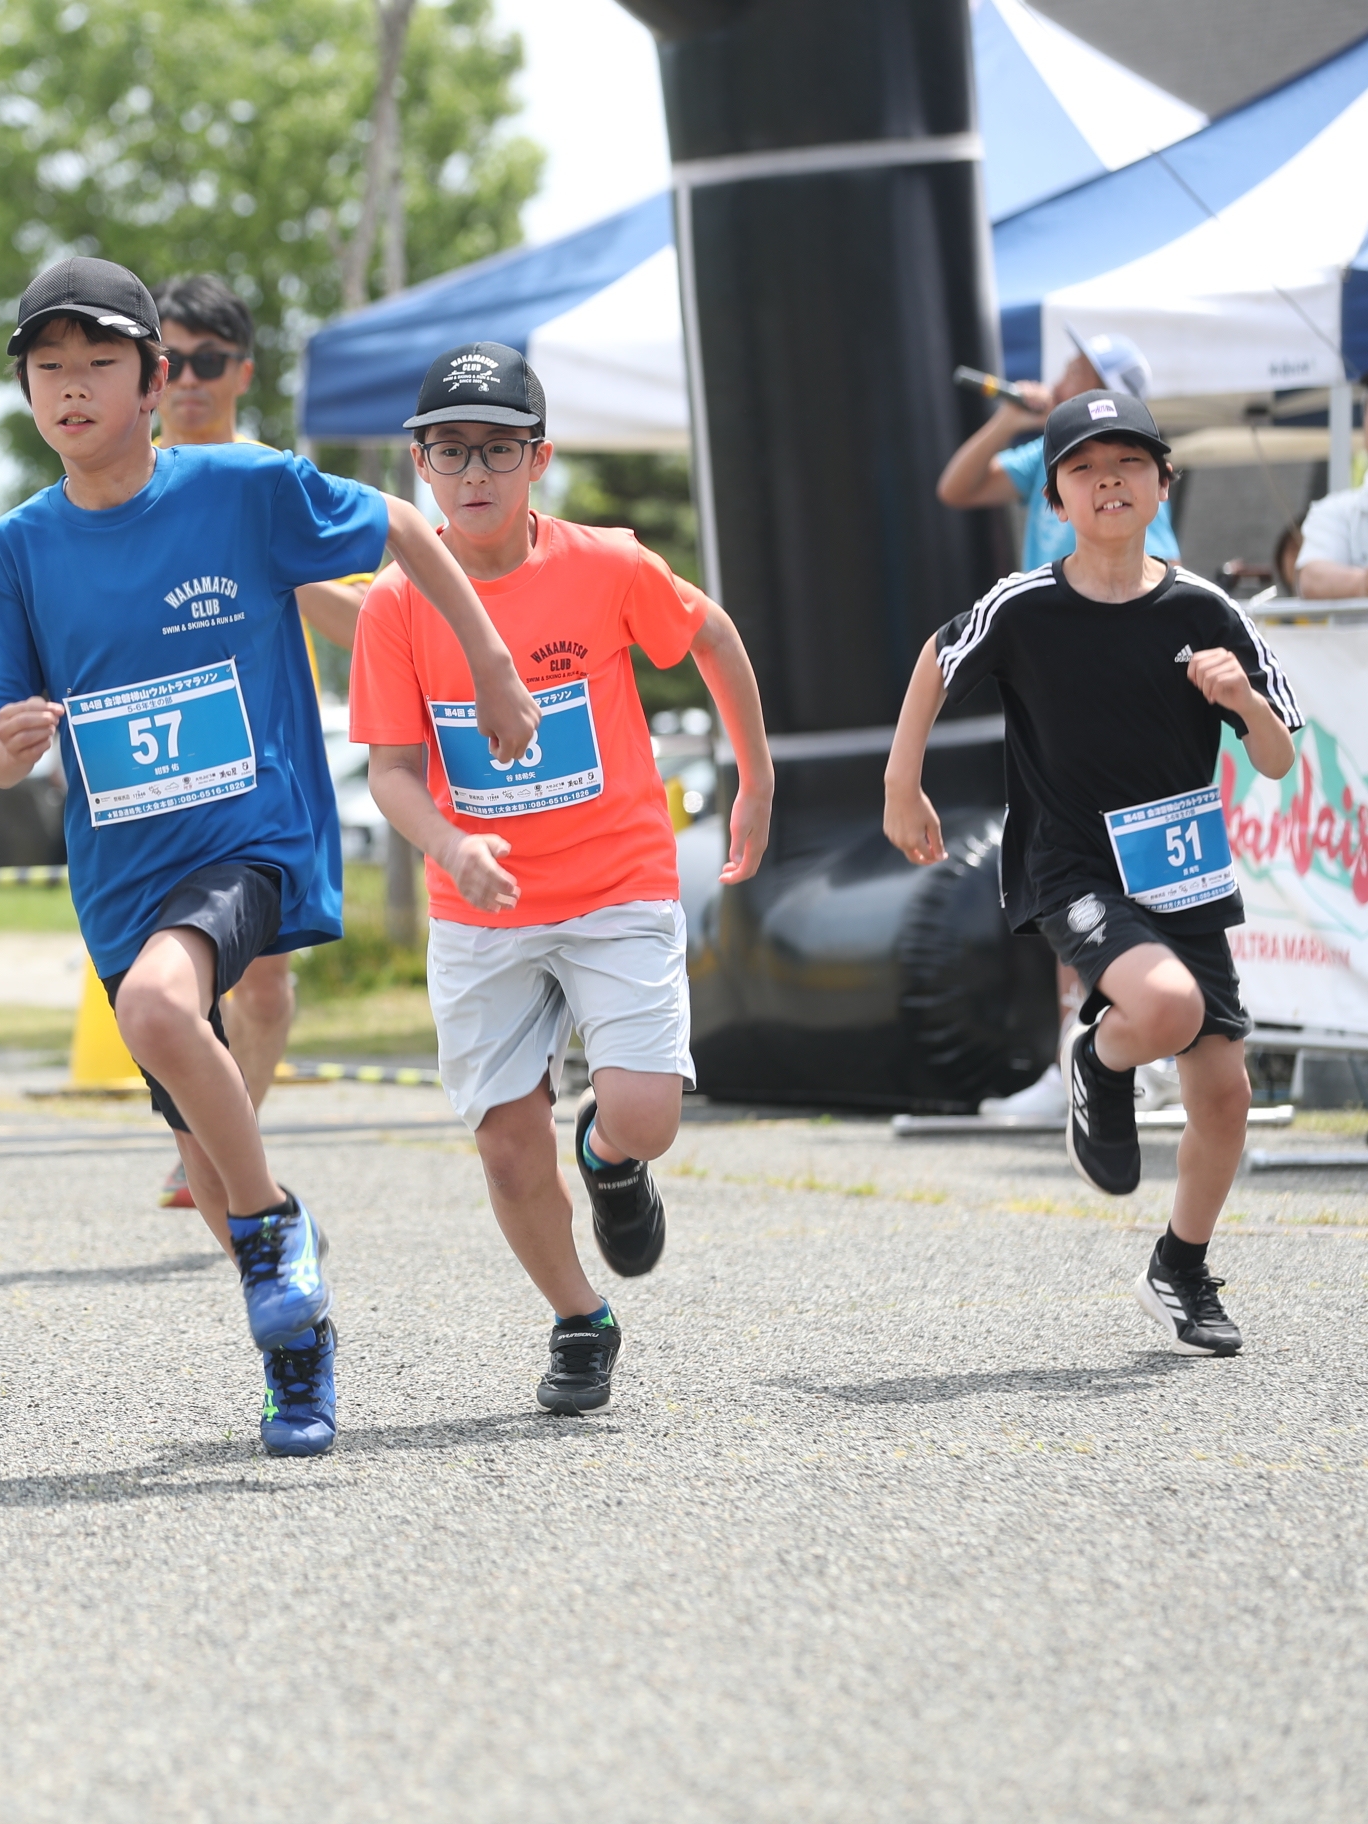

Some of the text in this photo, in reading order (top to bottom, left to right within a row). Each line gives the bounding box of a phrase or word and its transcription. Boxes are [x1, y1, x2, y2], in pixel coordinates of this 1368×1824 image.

[462, 363, 482, 371] CLUB
[163, 576, 238, 610] WAKAMATSU
[191, 598, 220, 619] CLUB
[162, 612, 245, 635] SWIM & SKIING & RUN & BIKE
[530, 640, 588, 664] WAKAMATSU
[550, 658, 571, 672] CLUB
[546, 673, 562, 681] SKIING
[80, 672, 218, 712] 第4回 会津磐梯山ウルトラマラソン
[127, 696, 173, 713] 5-6年生の部
[444, 708, 466, 718] 第4回
[128, 709, 182, 765] 57
[506, 774, 513, 782] 谷
[1123, 811, 1146, 824] 第4回
[1165, 820, 1202, 867] 51
